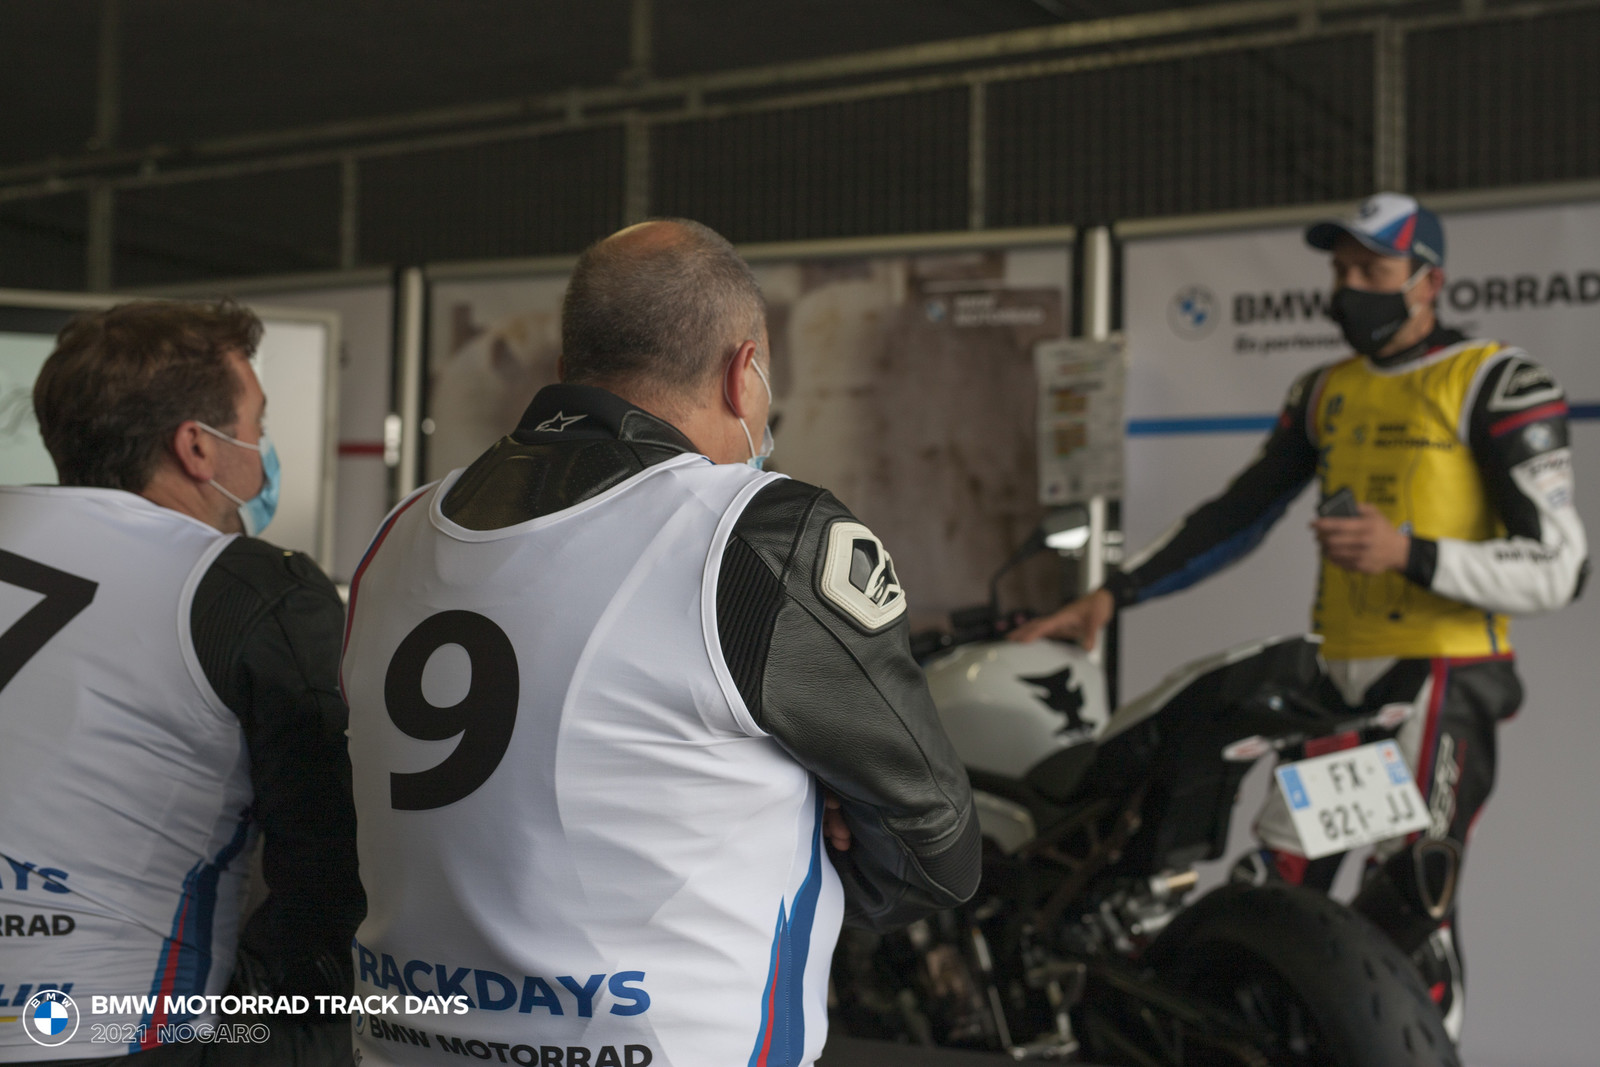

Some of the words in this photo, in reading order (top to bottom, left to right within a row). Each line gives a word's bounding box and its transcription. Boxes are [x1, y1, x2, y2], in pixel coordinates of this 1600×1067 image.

[1233, 290, 1334, 325] BMW
[1448, 271, 1600, 313] ORRAD
[384, 610, 519, 811] 9
[0, 914, 76, 937] RAD
[352, 937, 650, 1018] RACKDAYS
[370, 1014, 431, 1048] BMW
[436, 1034, 653, 1067] MOTORRAD
